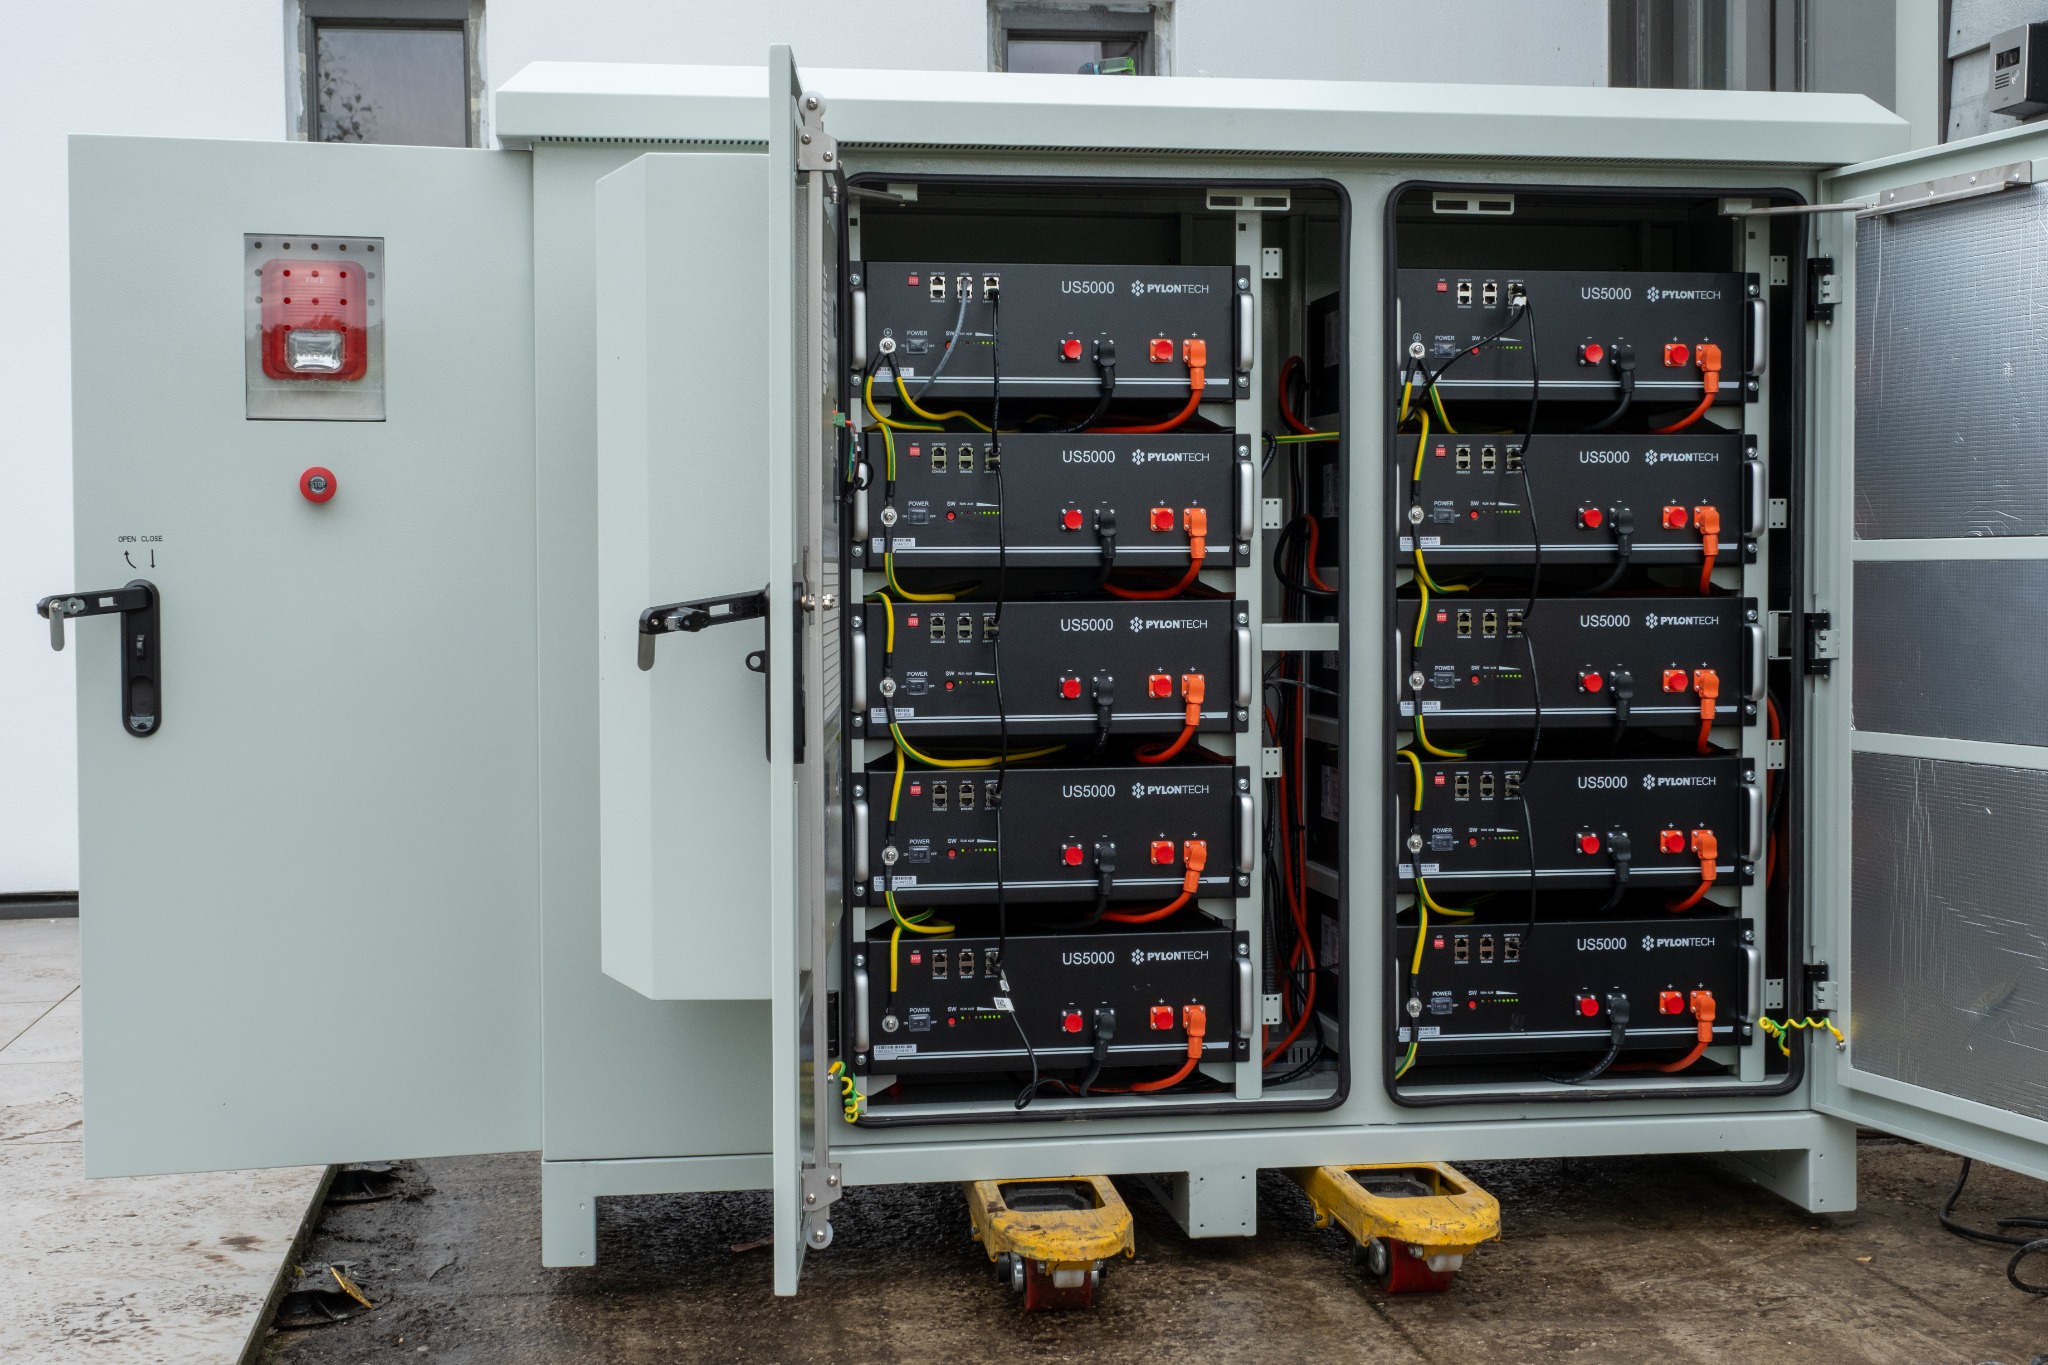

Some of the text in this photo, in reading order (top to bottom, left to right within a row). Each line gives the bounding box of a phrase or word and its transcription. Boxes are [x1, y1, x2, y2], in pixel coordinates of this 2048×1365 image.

[305, 276, 325, 284] FIRE
[1061, 280, 1115, 295] US5000
[1147, 283, 1209, 294] PYLONTECH
[1581, 286, 1632, 301] US5000
[1661, 290, 1721, 300] PYLONTECH
[1062, 450, 1116, 464] US5000
[1147, 452, 1210, 462] PYLONTECH
[1579, 450, 1630, 464] US5000
[1659, 452, 1719, 462] PYLONTECH
[1060, 618, 1114, 632] US5000
[1147, 619, 1208, 629] PYLONTECH
[1580, 614, 1631, 628] US5000
[1660, 615, 1719, 626] PYLONTECH
[1577, 775, 1628, 789] US5000
[1657, 776, 1717, 787] PYLONTECH
[1062, 784, 1116, 798] US5000
[1147, 784, 1210, 795] PYLONTECH
[1576, 937, 1627, 951] US5000
[1656, 937, 1715, 948] PYLONTECH
[1062, 951, 1115, 966] US5000
[1147, 950, 1209, 962] PYLONTECH
